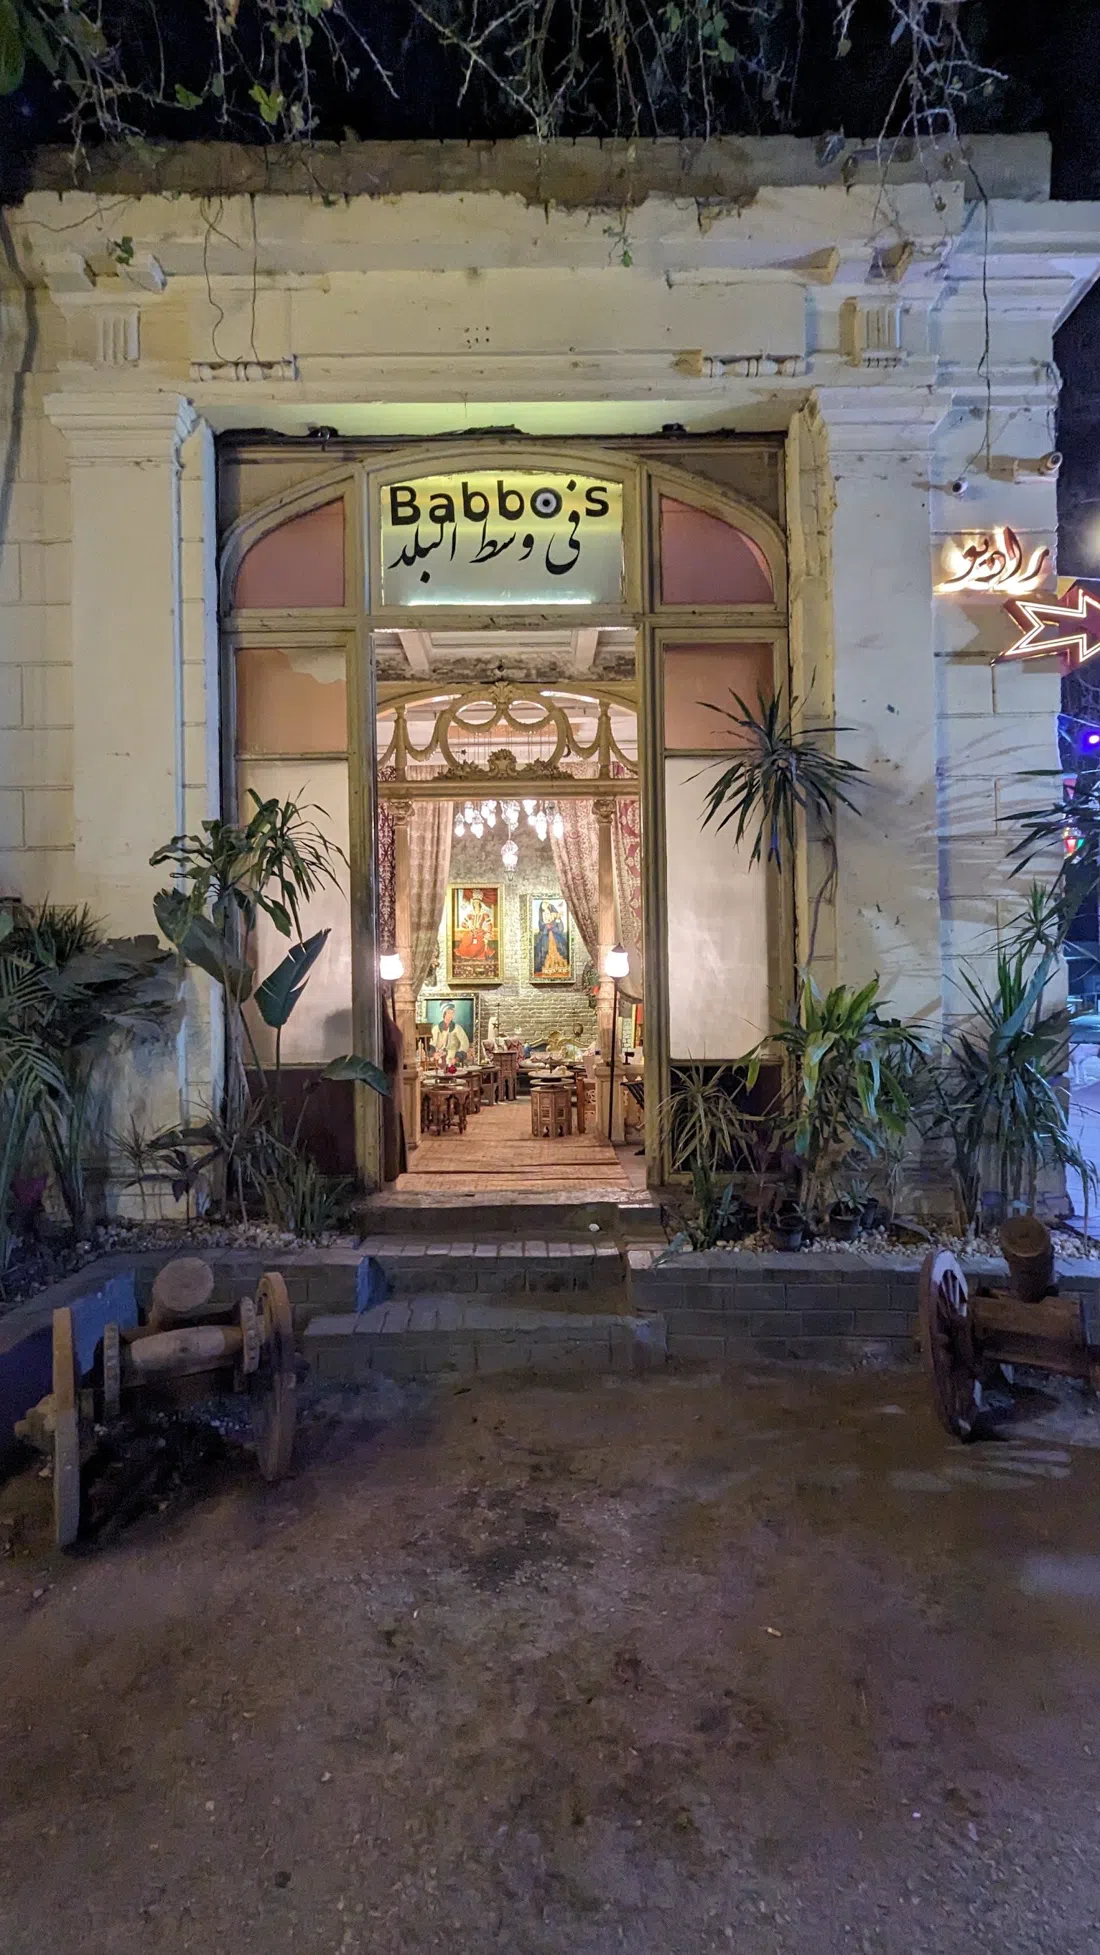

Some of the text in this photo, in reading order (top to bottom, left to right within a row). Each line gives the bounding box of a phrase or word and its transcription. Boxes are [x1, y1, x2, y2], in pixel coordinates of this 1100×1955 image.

[389, 479, 610, 526] Babbo's
[387, 519, 458, 583] البلد
[468, 518, 535, 563] وسط
